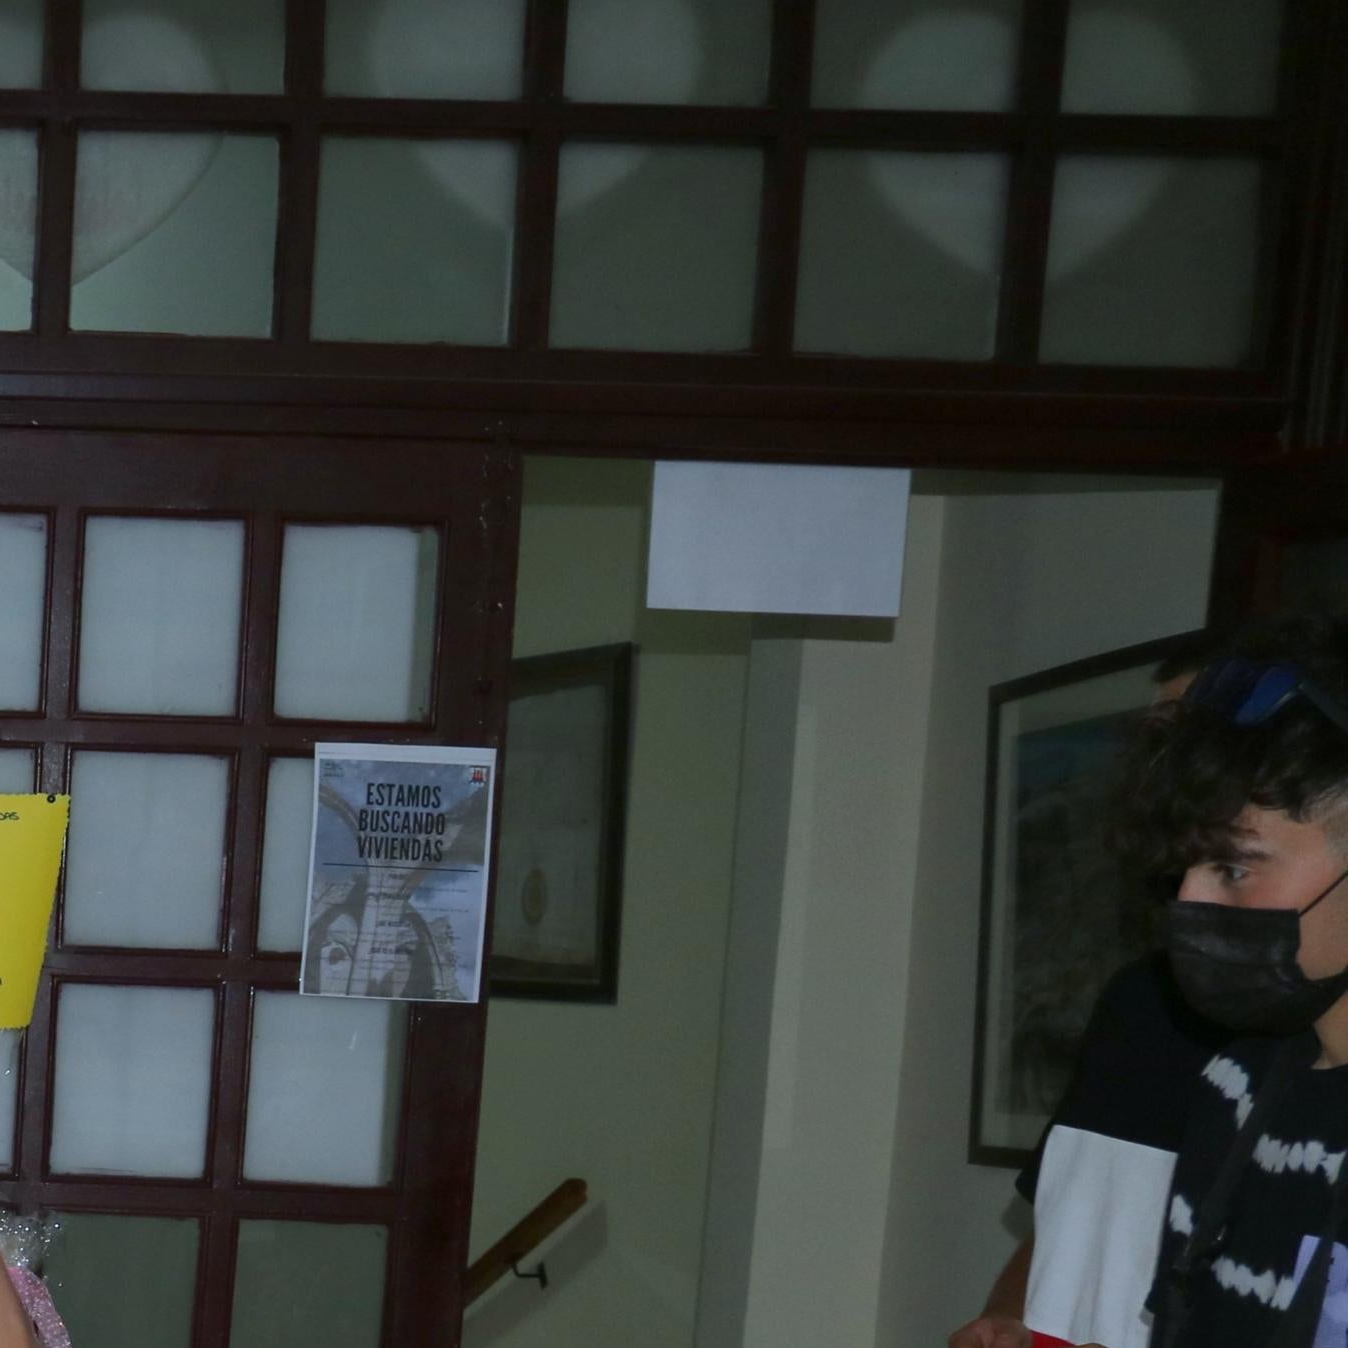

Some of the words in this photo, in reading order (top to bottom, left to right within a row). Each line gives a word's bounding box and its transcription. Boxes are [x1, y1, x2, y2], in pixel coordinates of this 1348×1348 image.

[366, 782, 442, 809] ESTAMOS
[358, 809, 446, 836] BUSCANDO
[357, 836, 444, 863] VIVIENDAS
